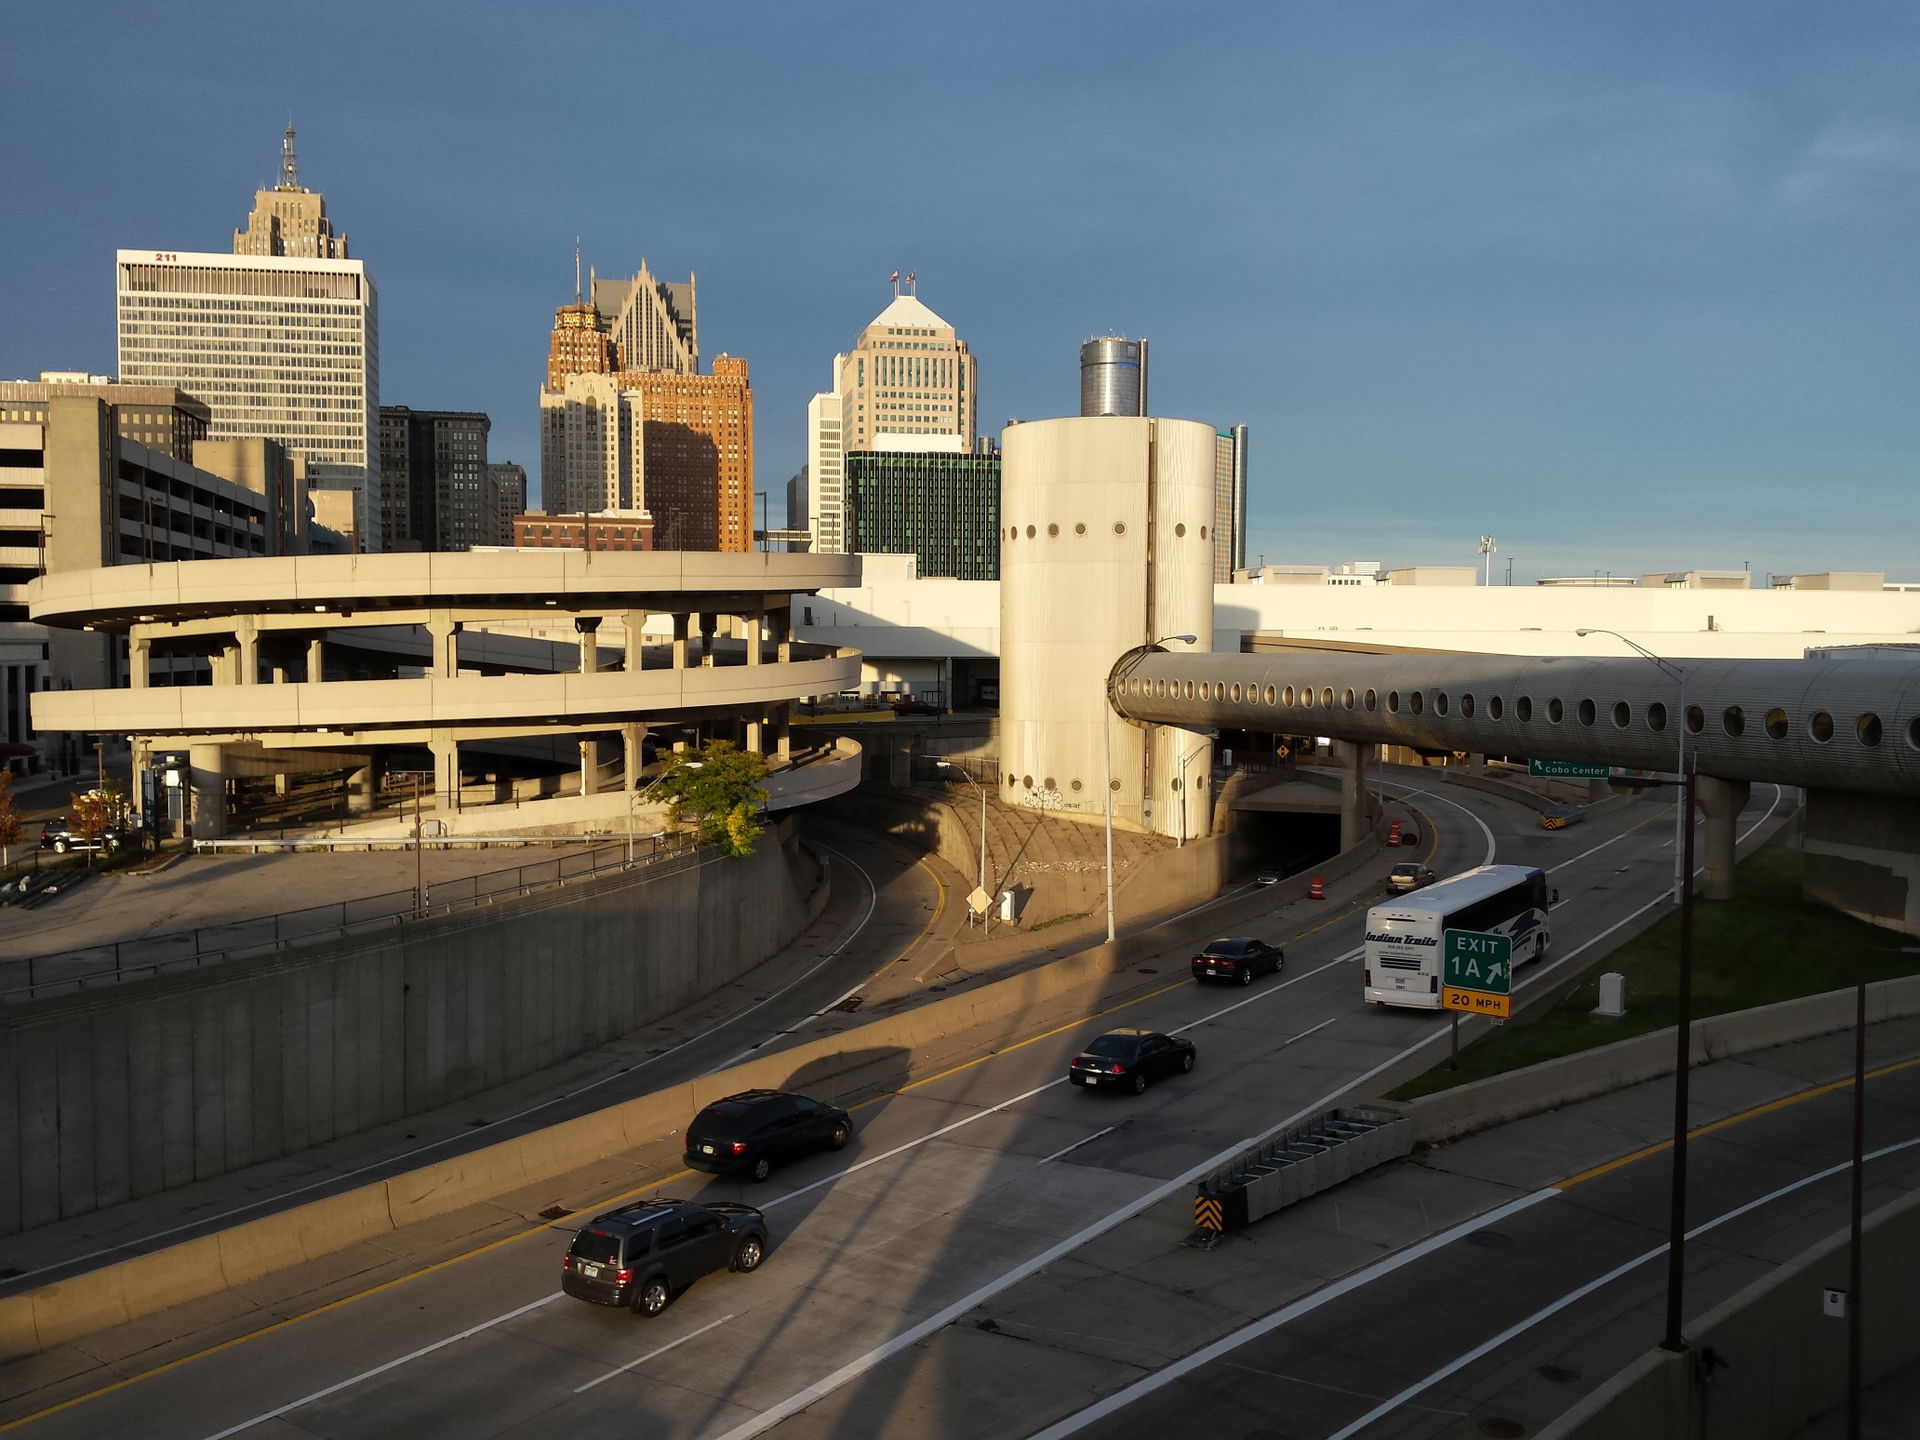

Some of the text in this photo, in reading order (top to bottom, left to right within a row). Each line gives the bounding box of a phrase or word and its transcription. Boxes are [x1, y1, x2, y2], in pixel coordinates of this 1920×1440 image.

[155, 253, 177, 262] 211
[1545, 766, 1605, 775] Cobo Center
[1365, 931, 1403, 944] Indian
[1403, 934, 1438, 947] Trails
[1457, 936, 1499, 954] EXIT
[1451, 956, 1481, 978] 1A
[1451, 993, 1501, 1011] 20 MPH
